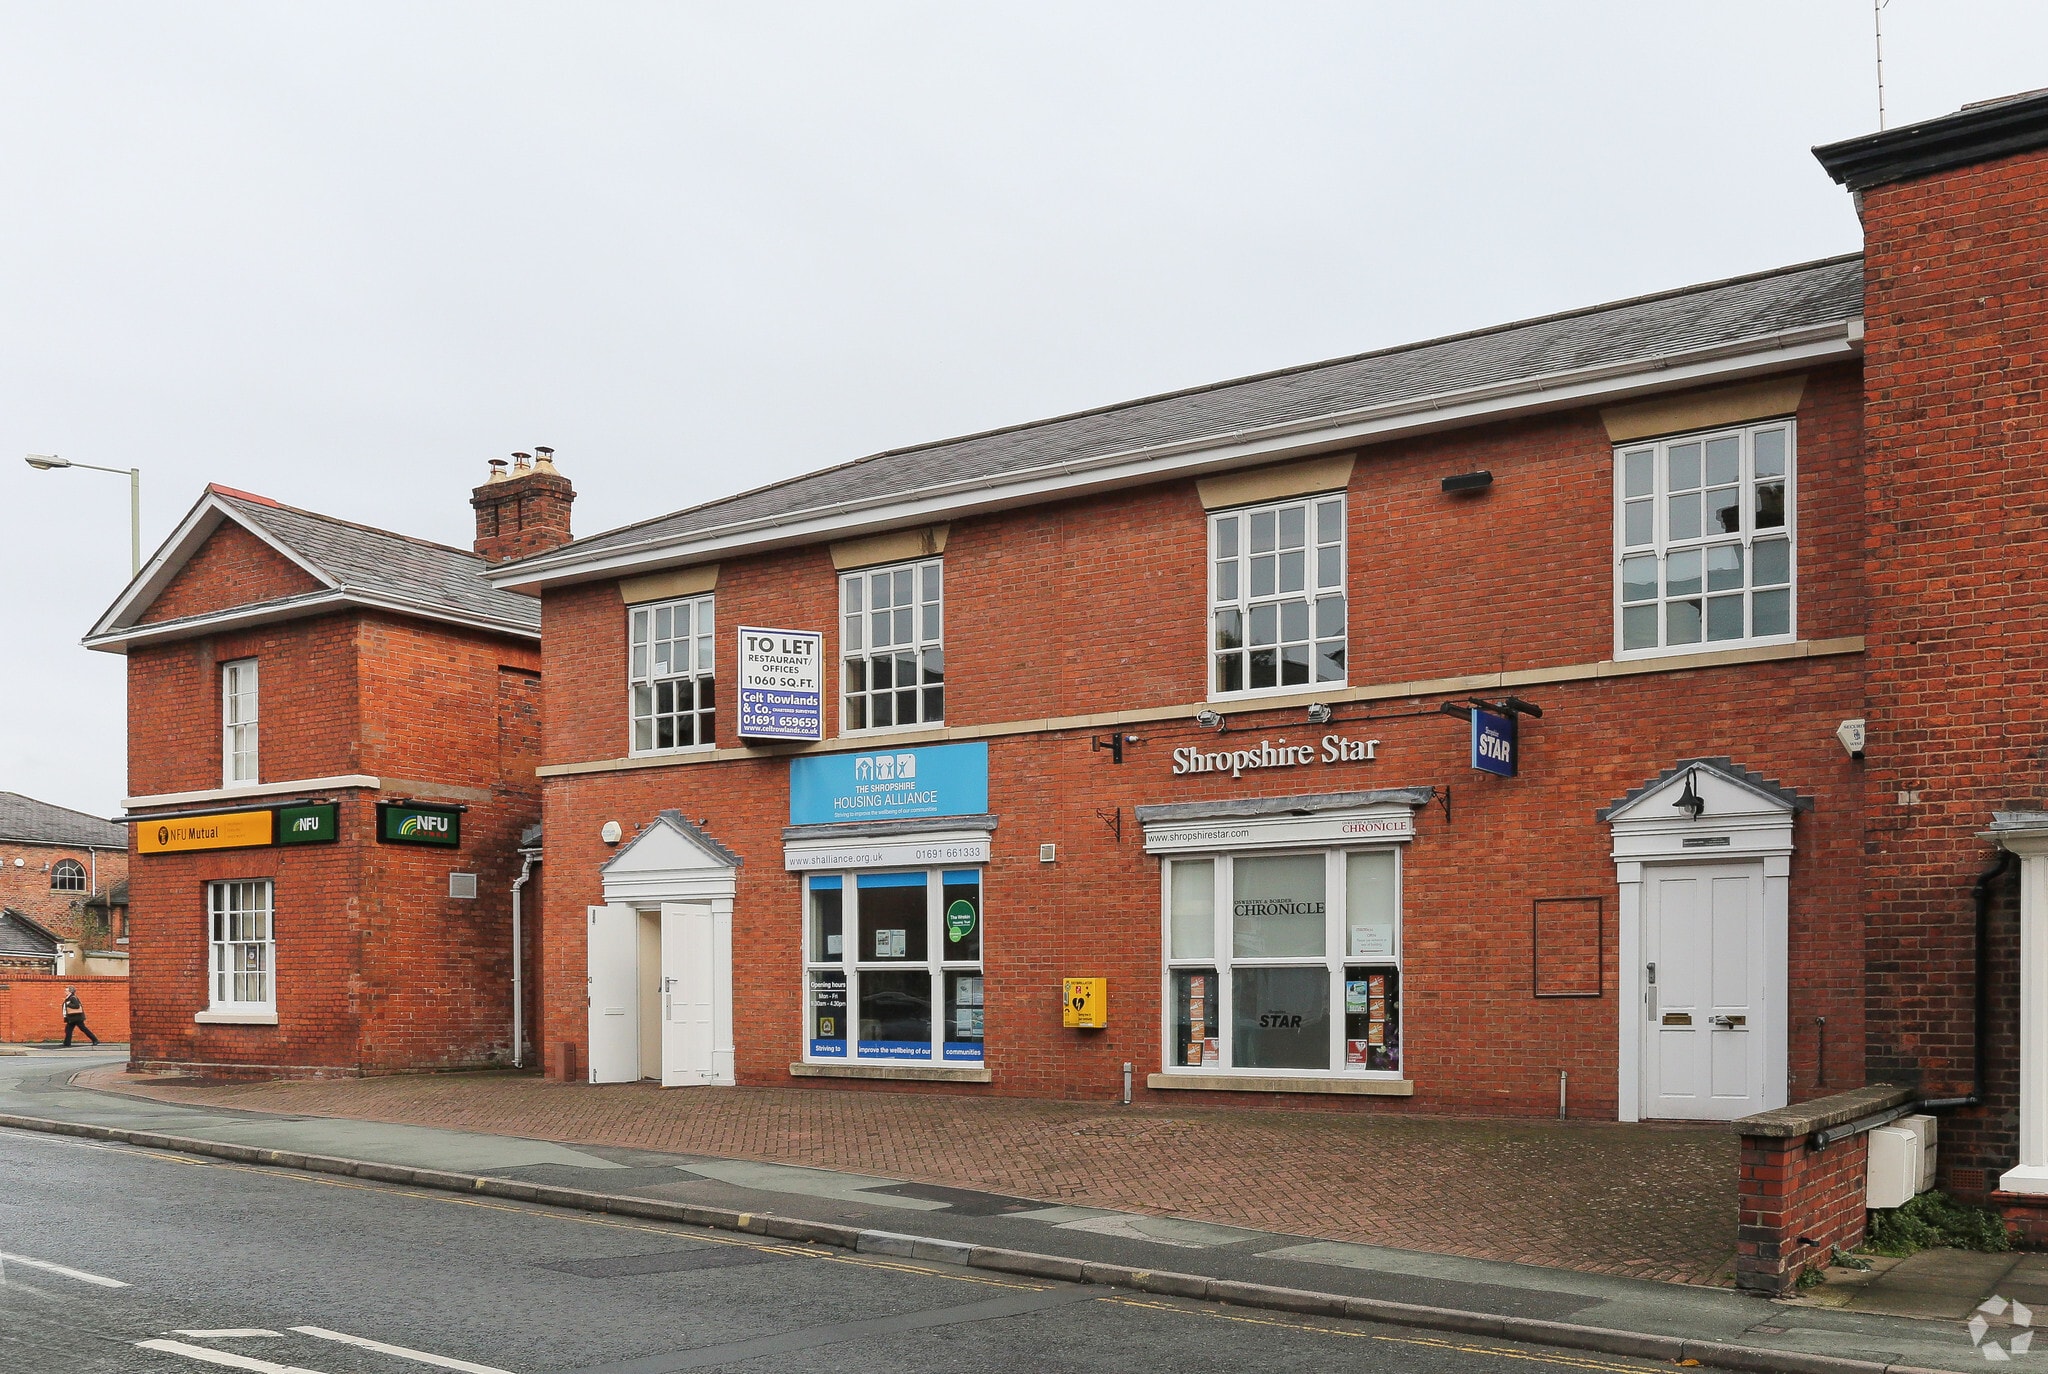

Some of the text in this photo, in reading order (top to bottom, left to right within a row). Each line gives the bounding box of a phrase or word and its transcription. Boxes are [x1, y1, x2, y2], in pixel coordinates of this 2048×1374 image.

[747, 636, 814, 655] TO LET
[748, 654, 812, 666] RESTAURANT/
[762, 664, 799, 674] OFFICES
[748, 675, 814, 688] 1060 SQ.FT.
[742, 692, 818, 706] Celt Rowlands
[743, 703, 751, 713] &
[755, 704, 772, 714] Co.
[743, 715, 818, 728] 01691 659659
[744, 725, 818, 735] www.celtrowlands.co.uk
[1479, 733, 1510, 763] STAR
[1173, 734, 1381, 778] Shropshire Star
[856, 781, 916, 794] THE SHROPSHIRE
[834, 790, 938, 809] HOUSING ALLIANCE
[300, 816, 319, 831] NFU
[416, 815, 449, 832] NFU
[1342, 821, 1407, 834] CHRONICLE
[170, 825, 219, 842] NFU Mutual
[1148, 828, 1249, 843] www.shropshirestar.com
[789, 847, 981, 866] www.shalliance.org.uk 01691 661333
[1234, 902, 1325, 917] CHRONICLE
[810, 981, 831, 989] Opening
[1259, 1014, 1302, 1028] STAR
[815, 1045, 834, 1053] Striving
[858, 1046, 880, 1054] improve
[889, 1047, 914, 1056] wellbeing
[945, 1048, 982, 1056] communities
